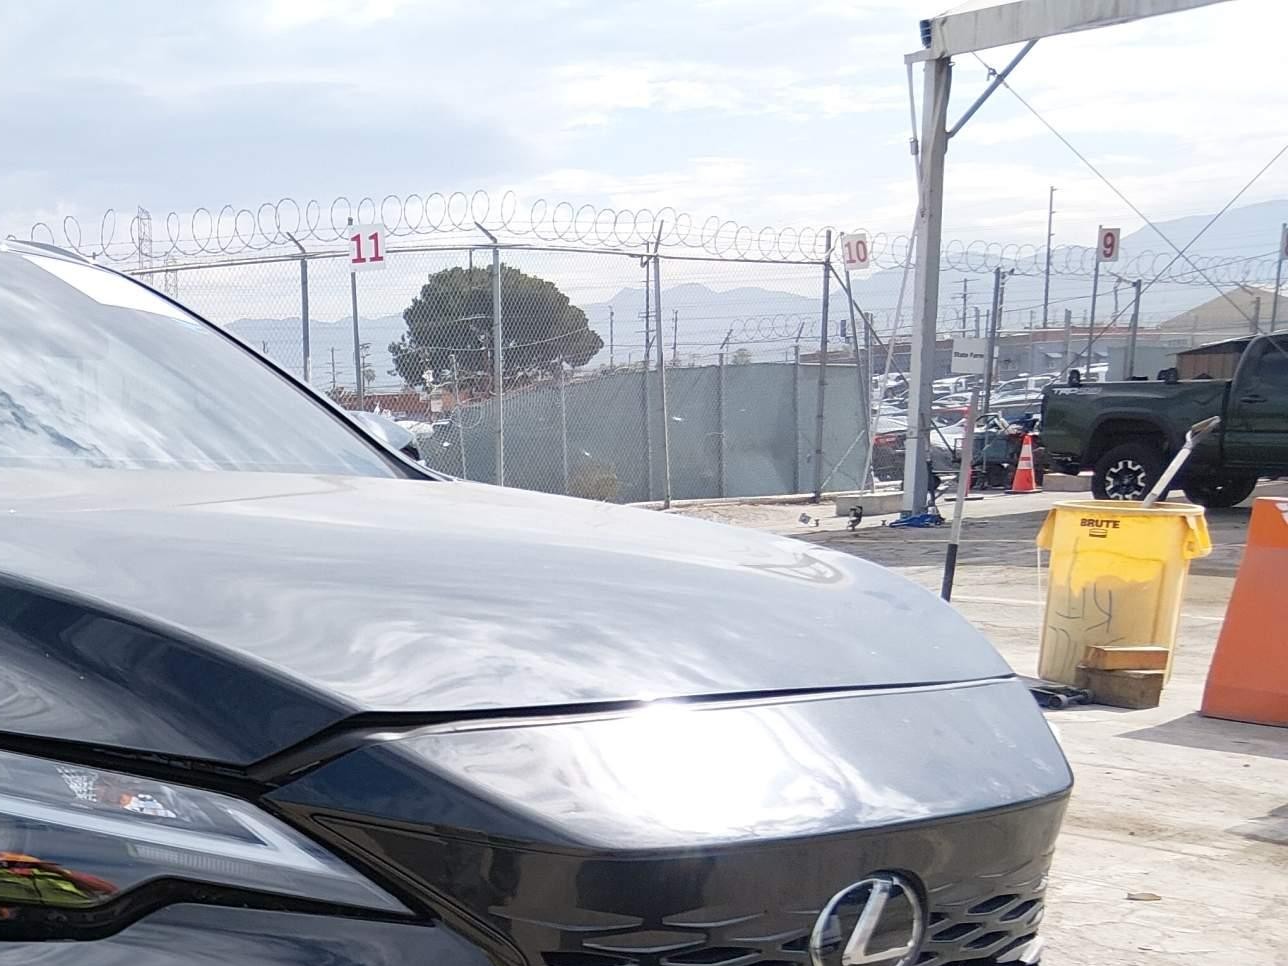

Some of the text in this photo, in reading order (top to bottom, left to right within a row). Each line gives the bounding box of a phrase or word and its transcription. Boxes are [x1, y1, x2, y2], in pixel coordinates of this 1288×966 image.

[350, 231, 384, 263] 11
[844, 240, 868, 263] 10
[1103, 231, 1116, 258] 9
[1080, 518, 1121, 529] BRUTE
